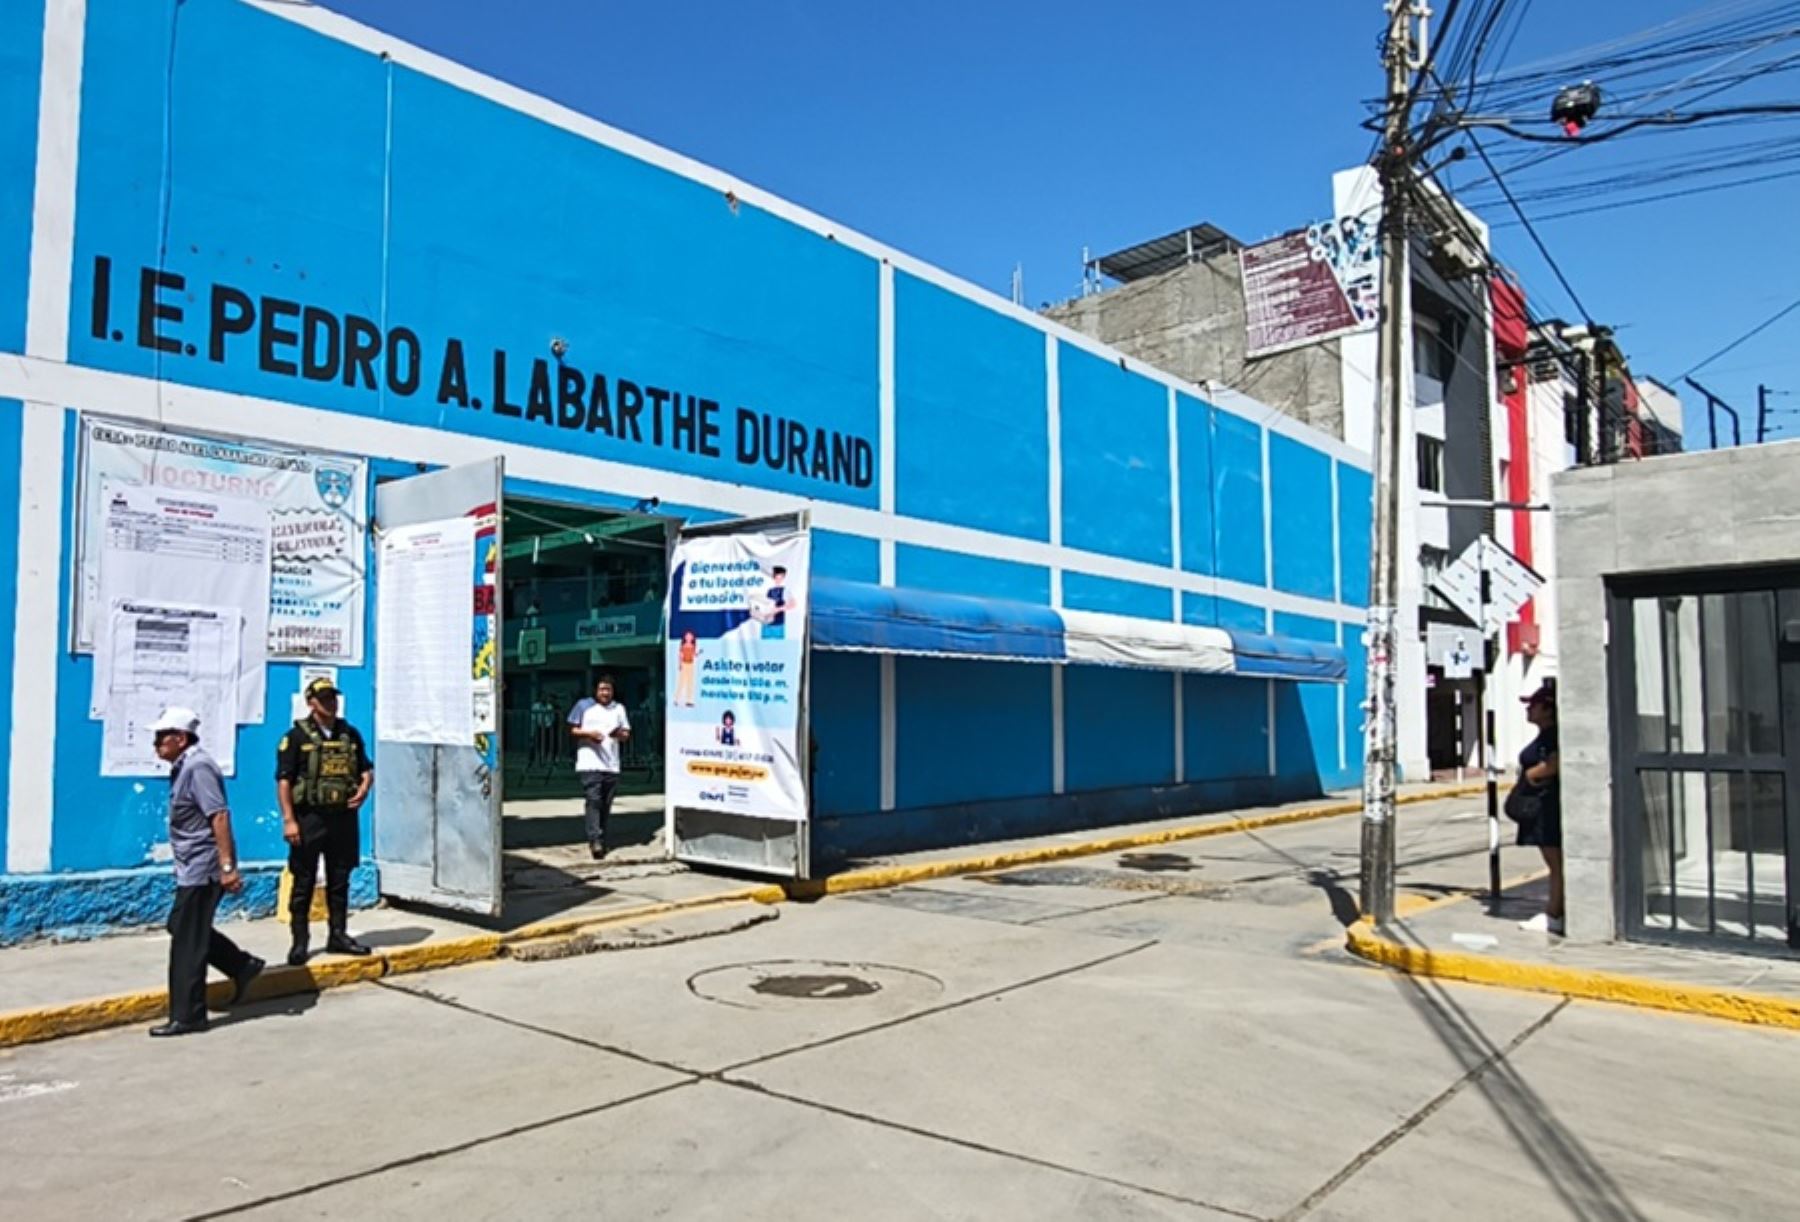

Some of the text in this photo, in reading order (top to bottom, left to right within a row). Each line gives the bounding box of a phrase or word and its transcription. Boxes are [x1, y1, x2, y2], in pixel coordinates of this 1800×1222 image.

[208, 283, 421, 397] PEDRO
[437, 338, 482, 411] A.
[492, 349, 721, 458] LABARTHE
[736, 407, 873, 489] DURAND
